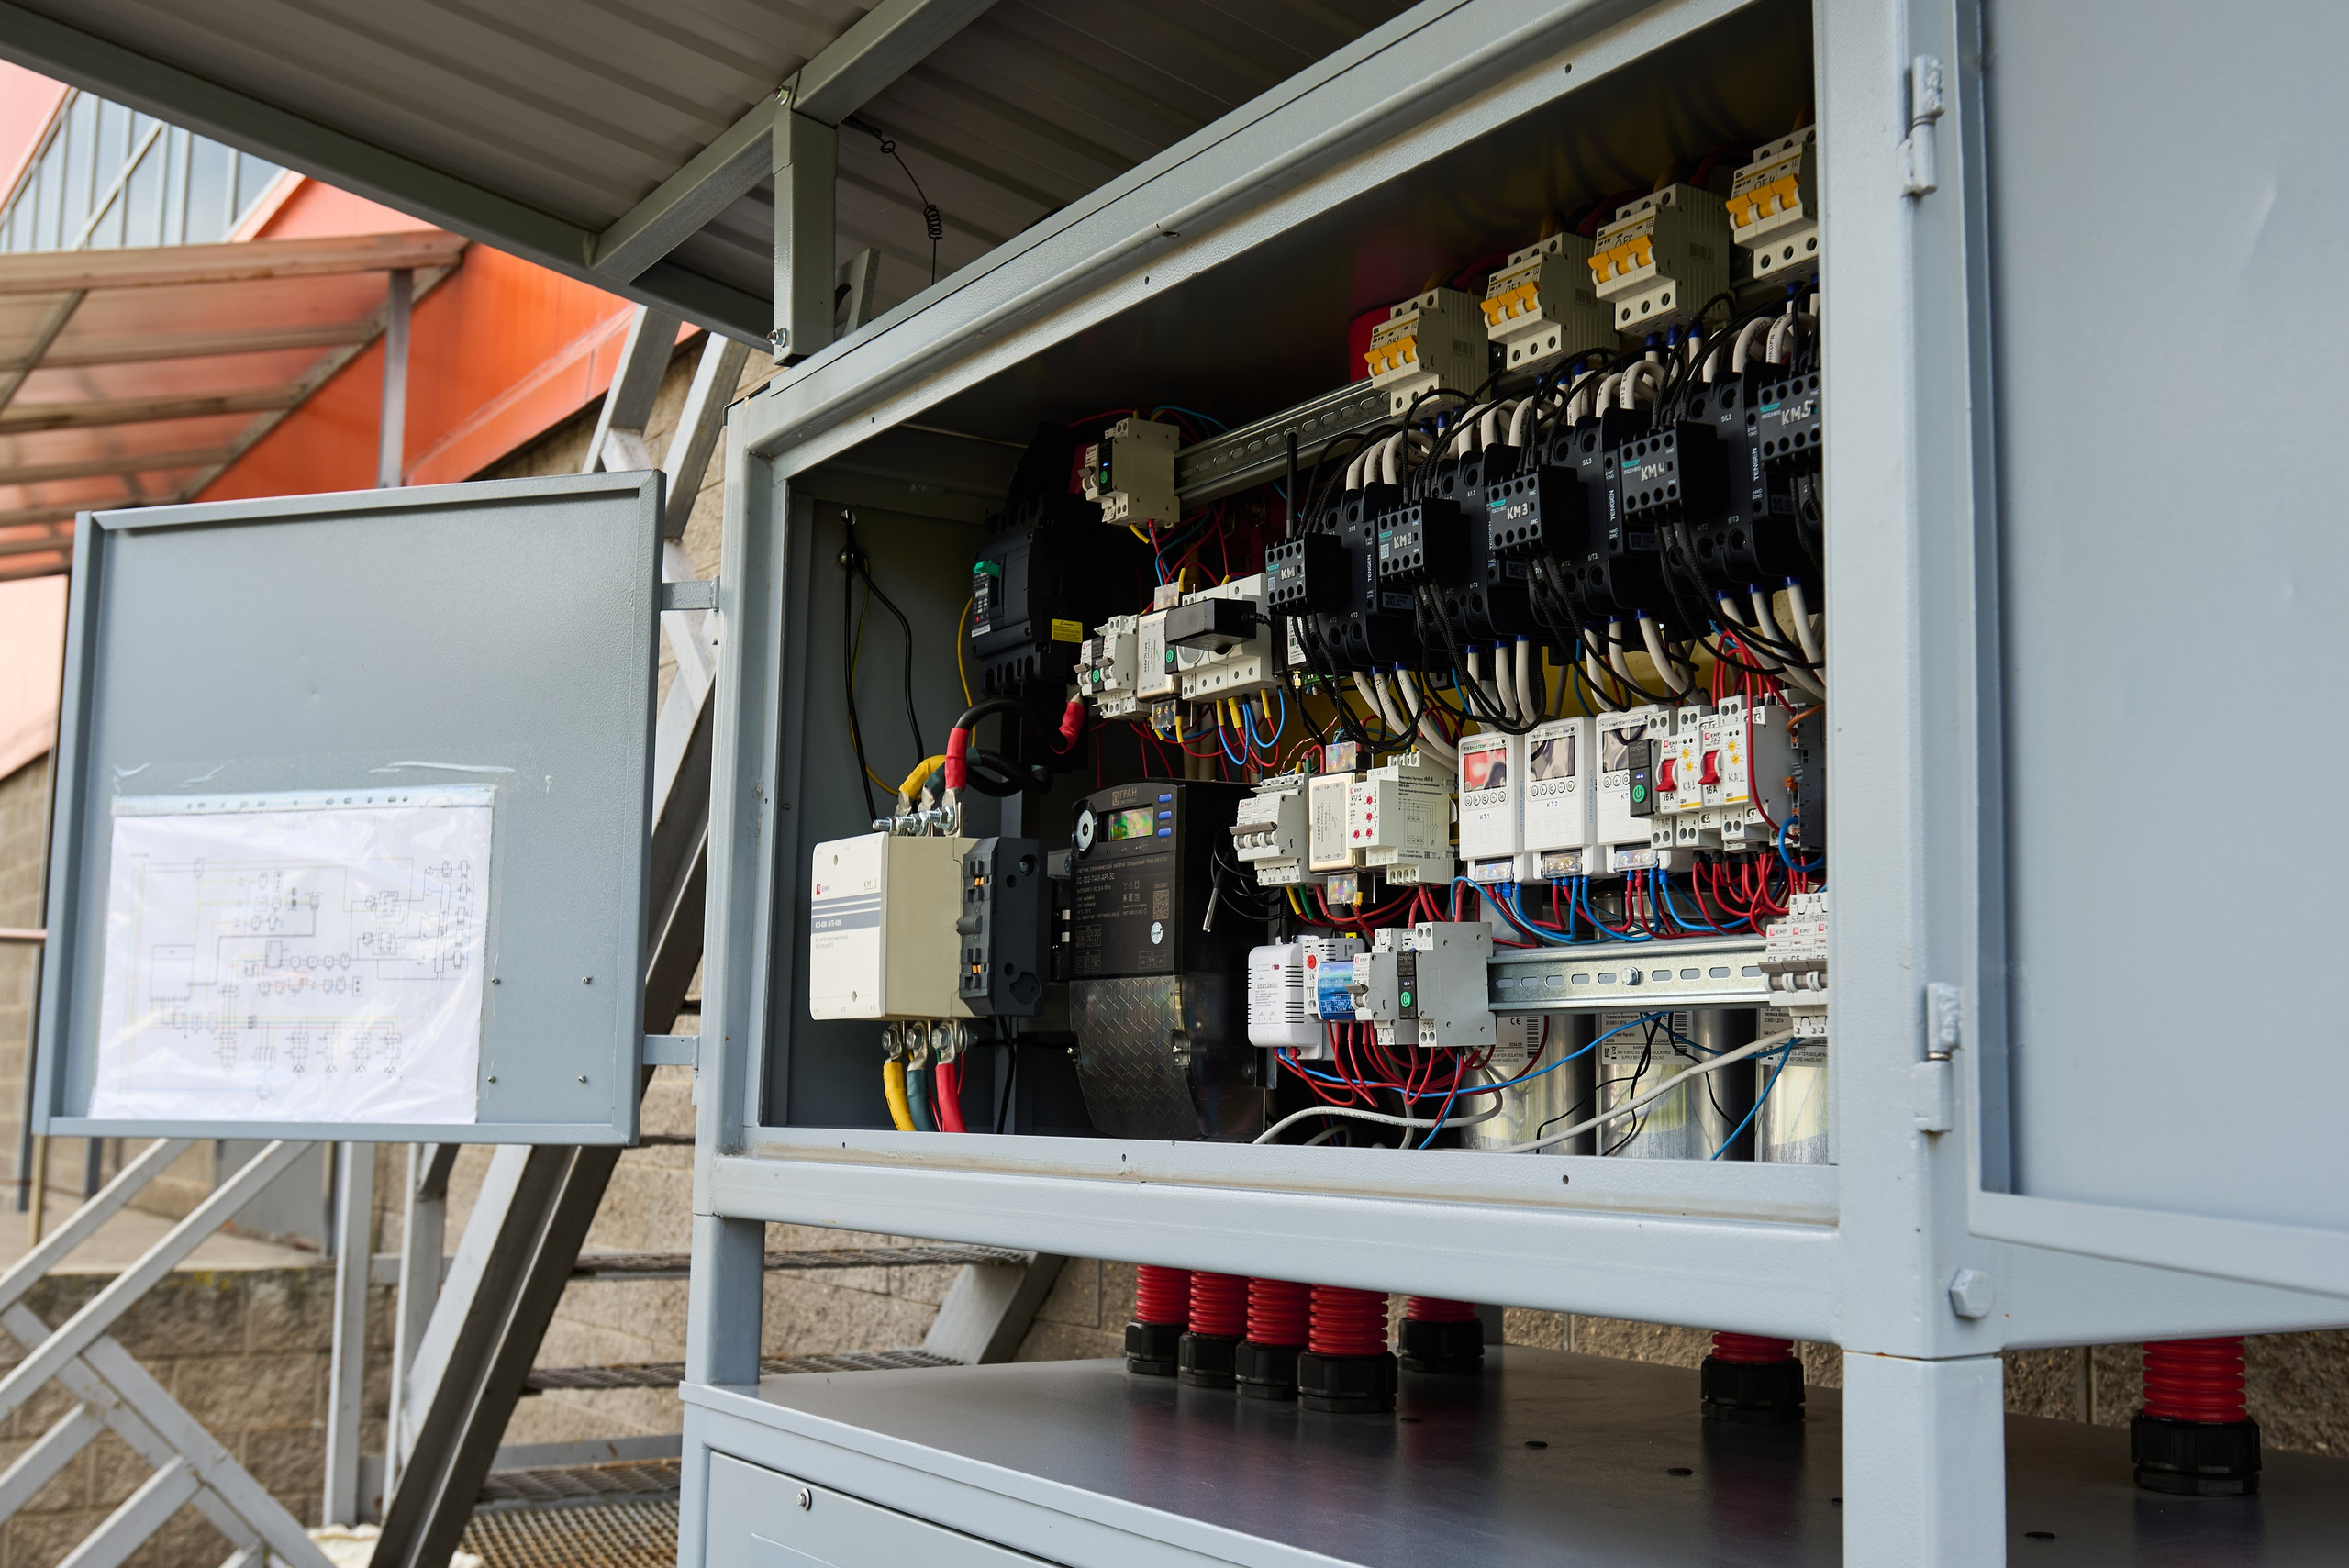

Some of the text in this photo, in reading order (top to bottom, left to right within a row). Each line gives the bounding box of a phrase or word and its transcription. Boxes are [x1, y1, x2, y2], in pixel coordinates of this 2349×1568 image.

[1781, 399, 1814, 426] KM5
[1642, 462, 1666, 482] KM4
[1752, 447, 1760, 482] TENGEN
[1507, 502, 1530, 521] KM3
[1393, 531, 1413, 550] KM2
[1728, 772, 1745, 783] KA2
[1119, 788, 1137, 798] ГРАН
[1663, 793, 1675, 801] 16A
[1706, 785, 1718, 795] 16A
[1422, 1021, 1435, 1032] SB3
